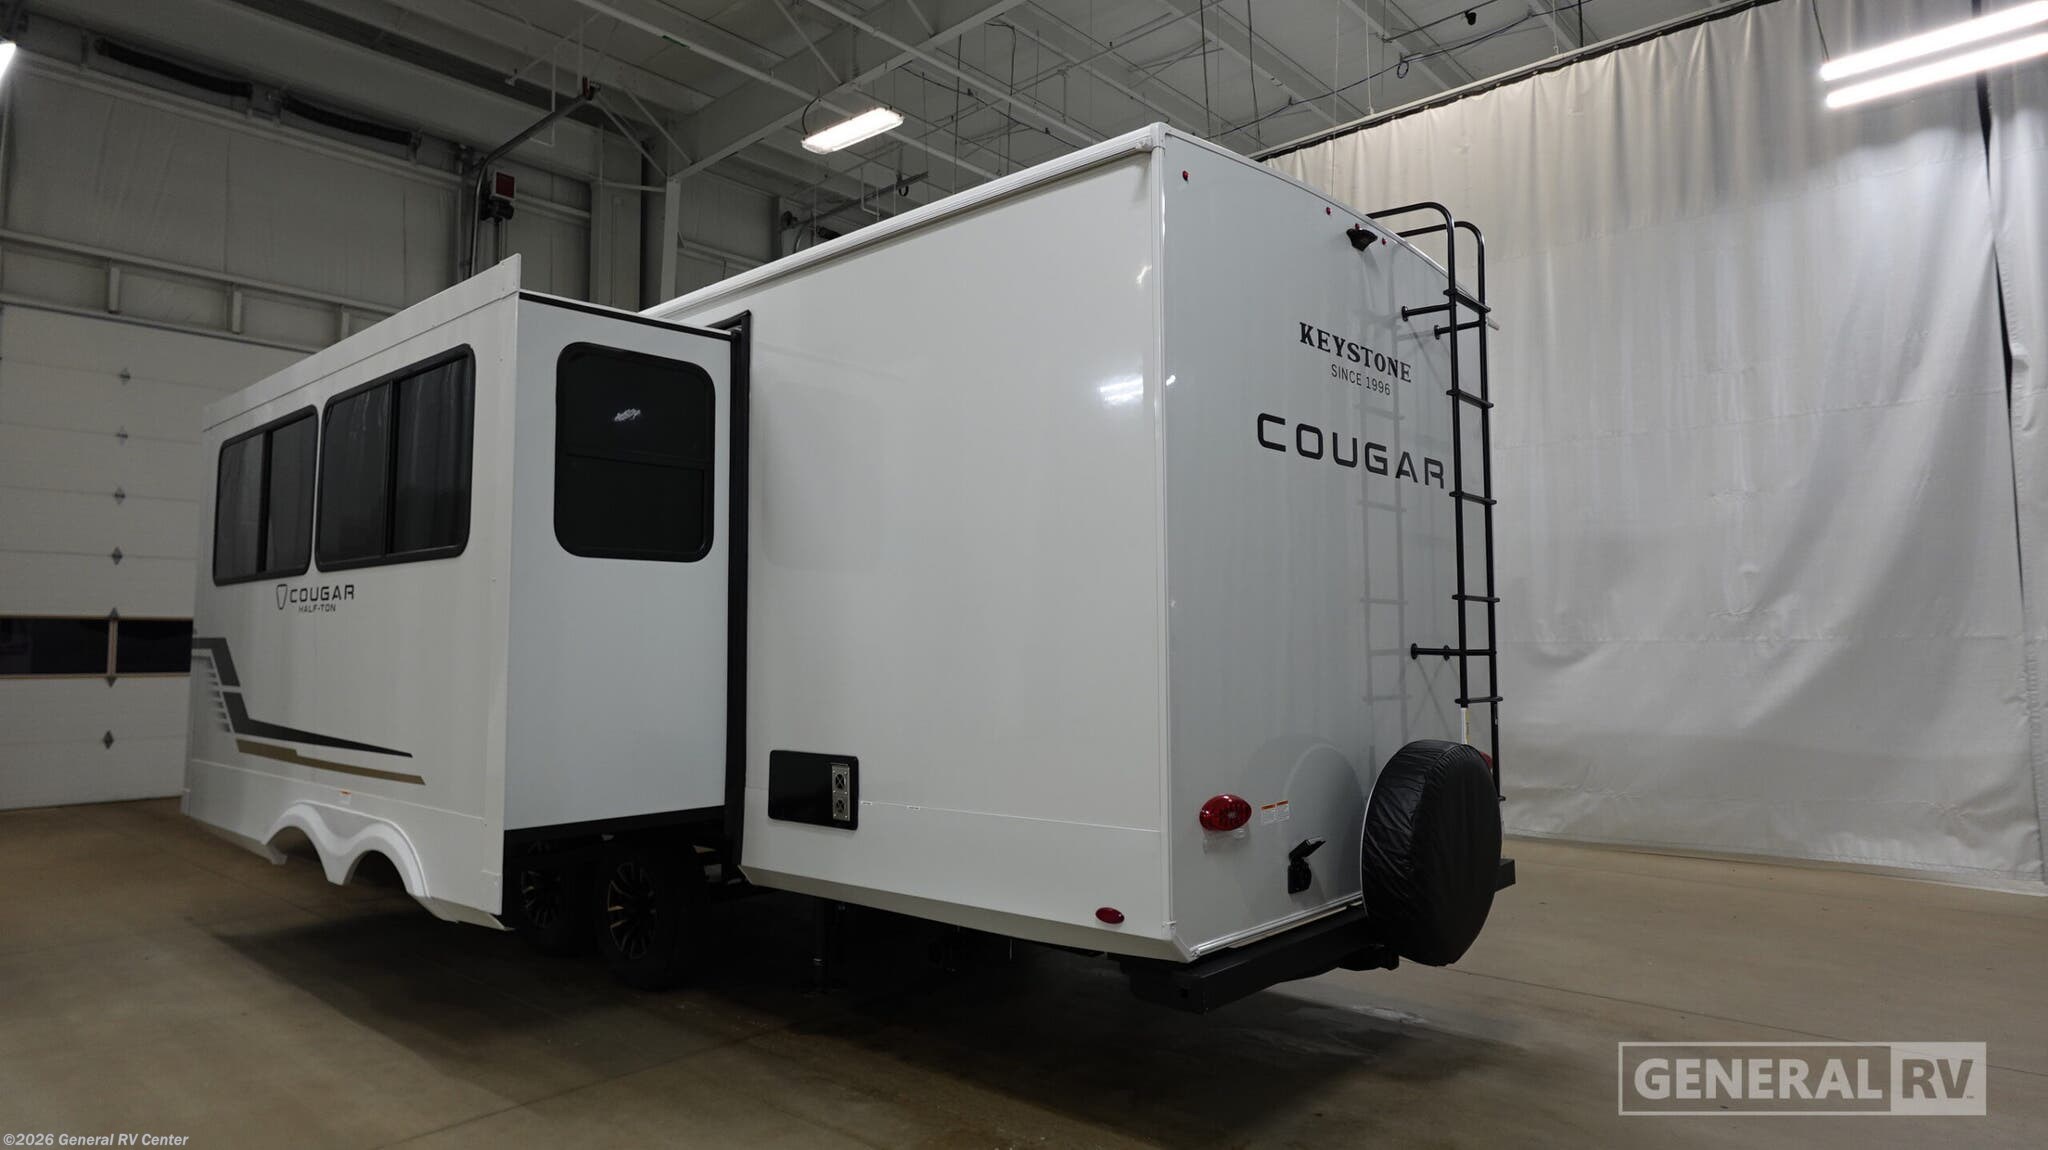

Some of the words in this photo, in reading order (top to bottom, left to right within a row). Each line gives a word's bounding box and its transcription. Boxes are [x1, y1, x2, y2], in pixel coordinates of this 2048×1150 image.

[1299, 321, 1412, 383] KEYSTONE
[1331, 363, 1362, 386] SINCE
[1366, 376, 1391, 396] 1996
[1257, 412, 1444, 489] COUGAR
[290, 584, 354, 603] COUGAR
[299, 603, 336, 613] HALF-TON
